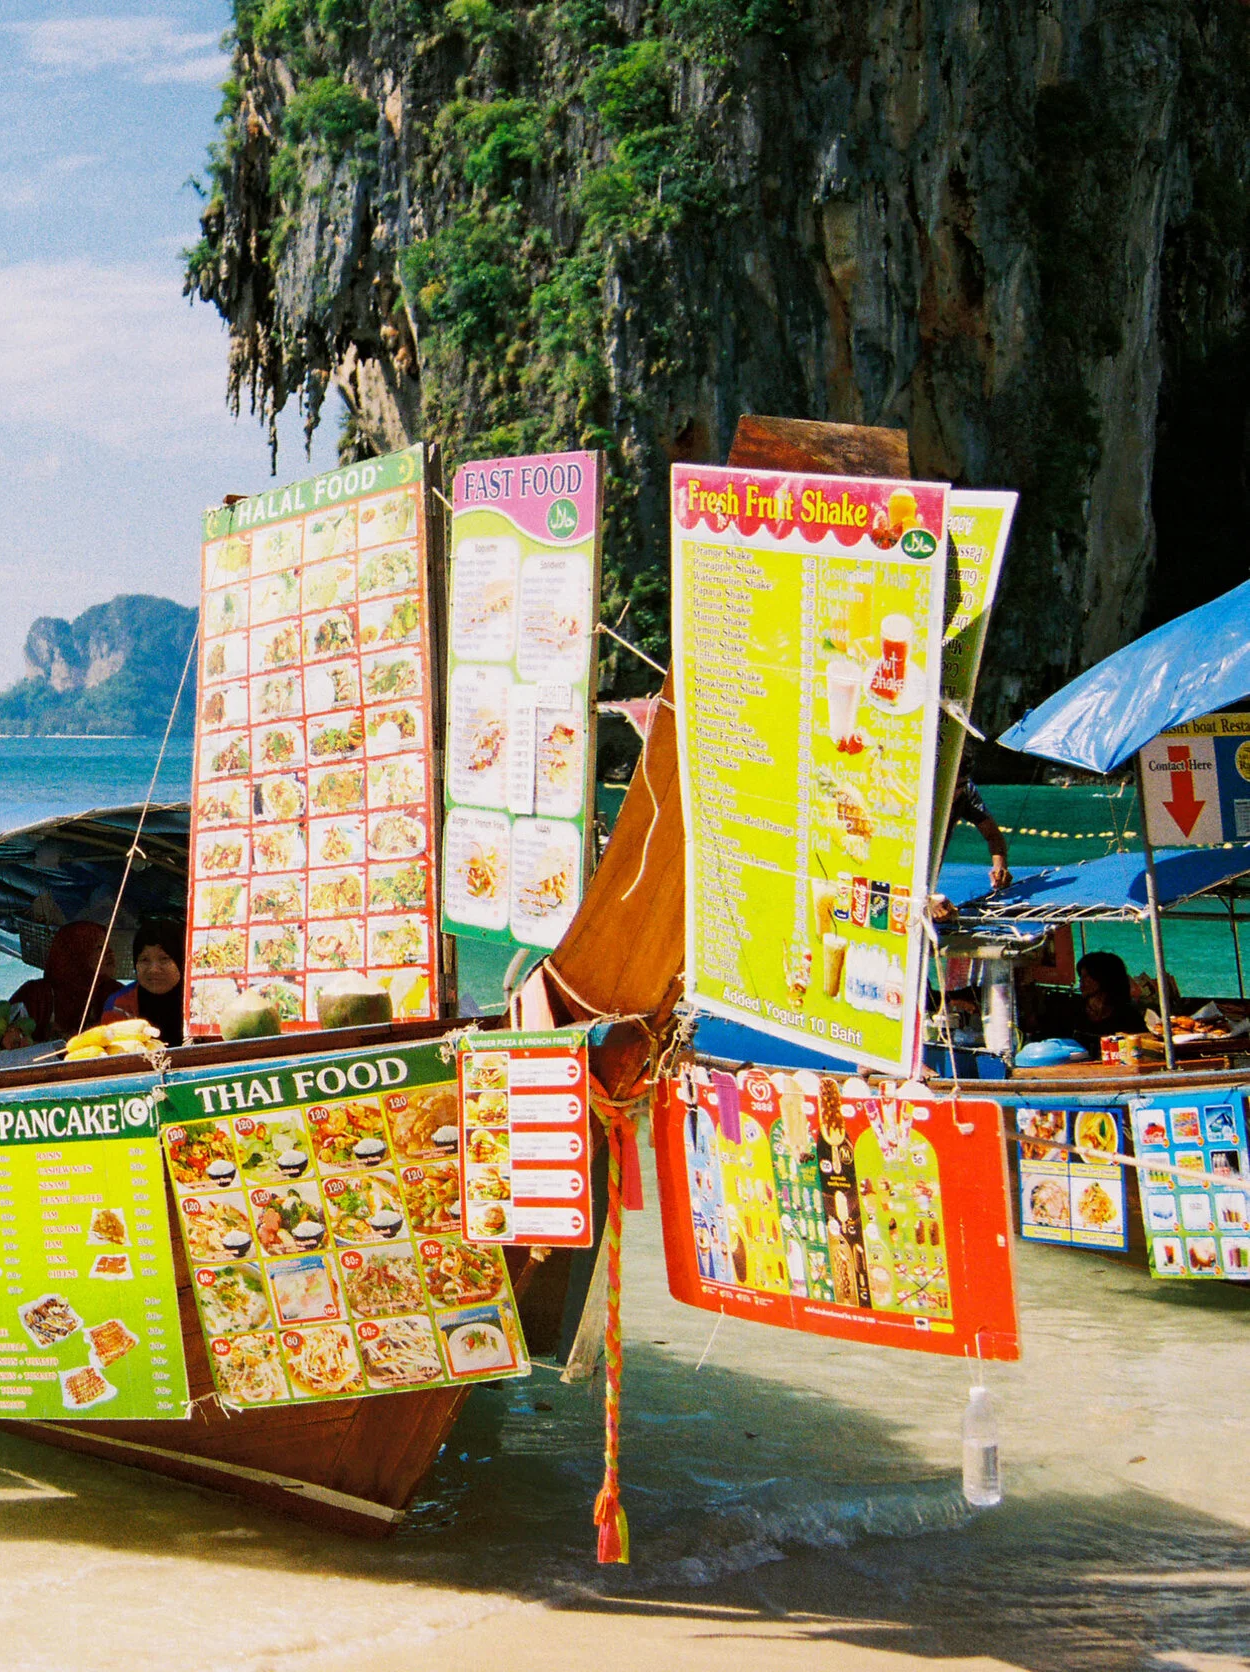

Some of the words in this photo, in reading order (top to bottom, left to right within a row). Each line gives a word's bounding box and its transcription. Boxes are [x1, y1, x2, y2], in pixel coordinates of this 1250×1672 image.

[464, 469, 514, 500] FAST
[521, 464, 582, 496] FOOD
[238, 488, 305, 527] HALAL
[314, 465, 377, 505] FOOD
[687, 479, 739, 516] Fresh
[745, 484, 794, 521] Fruit
[801, 489, 868, 528] Shake
[693, 544, 724, 557] Orange
[726, 548, 752, 559] Shake
[693, 558, 733, 572] Pineapple
[736, 563, 762, 575] Shake
[693, 571, 742, 586] Watermelon
[745, 578, 772, 590] Shake
[693, 584, 722, 598] Papaya
[725, 589, 751, 600] Shake
[726, 602, 752, 613] Shake
[694, 611, 720, 624] Mango
[723, 615, 748, 626] Shake
[722, 628, 748, 640] Shake
[719, 641, 745, 652] Shake
[722, 654, 748, 665] Shake
[736, 669, 762, 681] Shake
[740, 683, 767, 697] Shake
[721, 692, 746, 705] Shake
[714, 704, 738, 717] Shake
[729, 721, 754, 733] Shake
[1193, 720, 1217, 733] boat
[742, 736, 767, 749] Shake
[747, 751, 774, 764] Shake
[1148, 760, 1185, 771] Contact
[1189, 759, 1212, 770] Here
[723, 986, 761, 1012] Added
[764, 1000, 805, 1027] Yogurt
[810, 1017, 825, 1034] 10
[831, 1022, 862, 1046] Baht
[195, 1076, 284, 1113] THAI
[292, 1057, 409, 1099] FOOD
[389, 1096, 407, 1108] 120
[310, 1108, 328, 1121] 120
[236, 1119, 253, 1130] 120
[168, 1128, 184, 1141] 120
[406, 1169, 424, 1182] 120
[327, 1182, 345, 1193] 120
[252, 1192, 270, 1203] 120
[184, 1201, 200, 1213] 120
